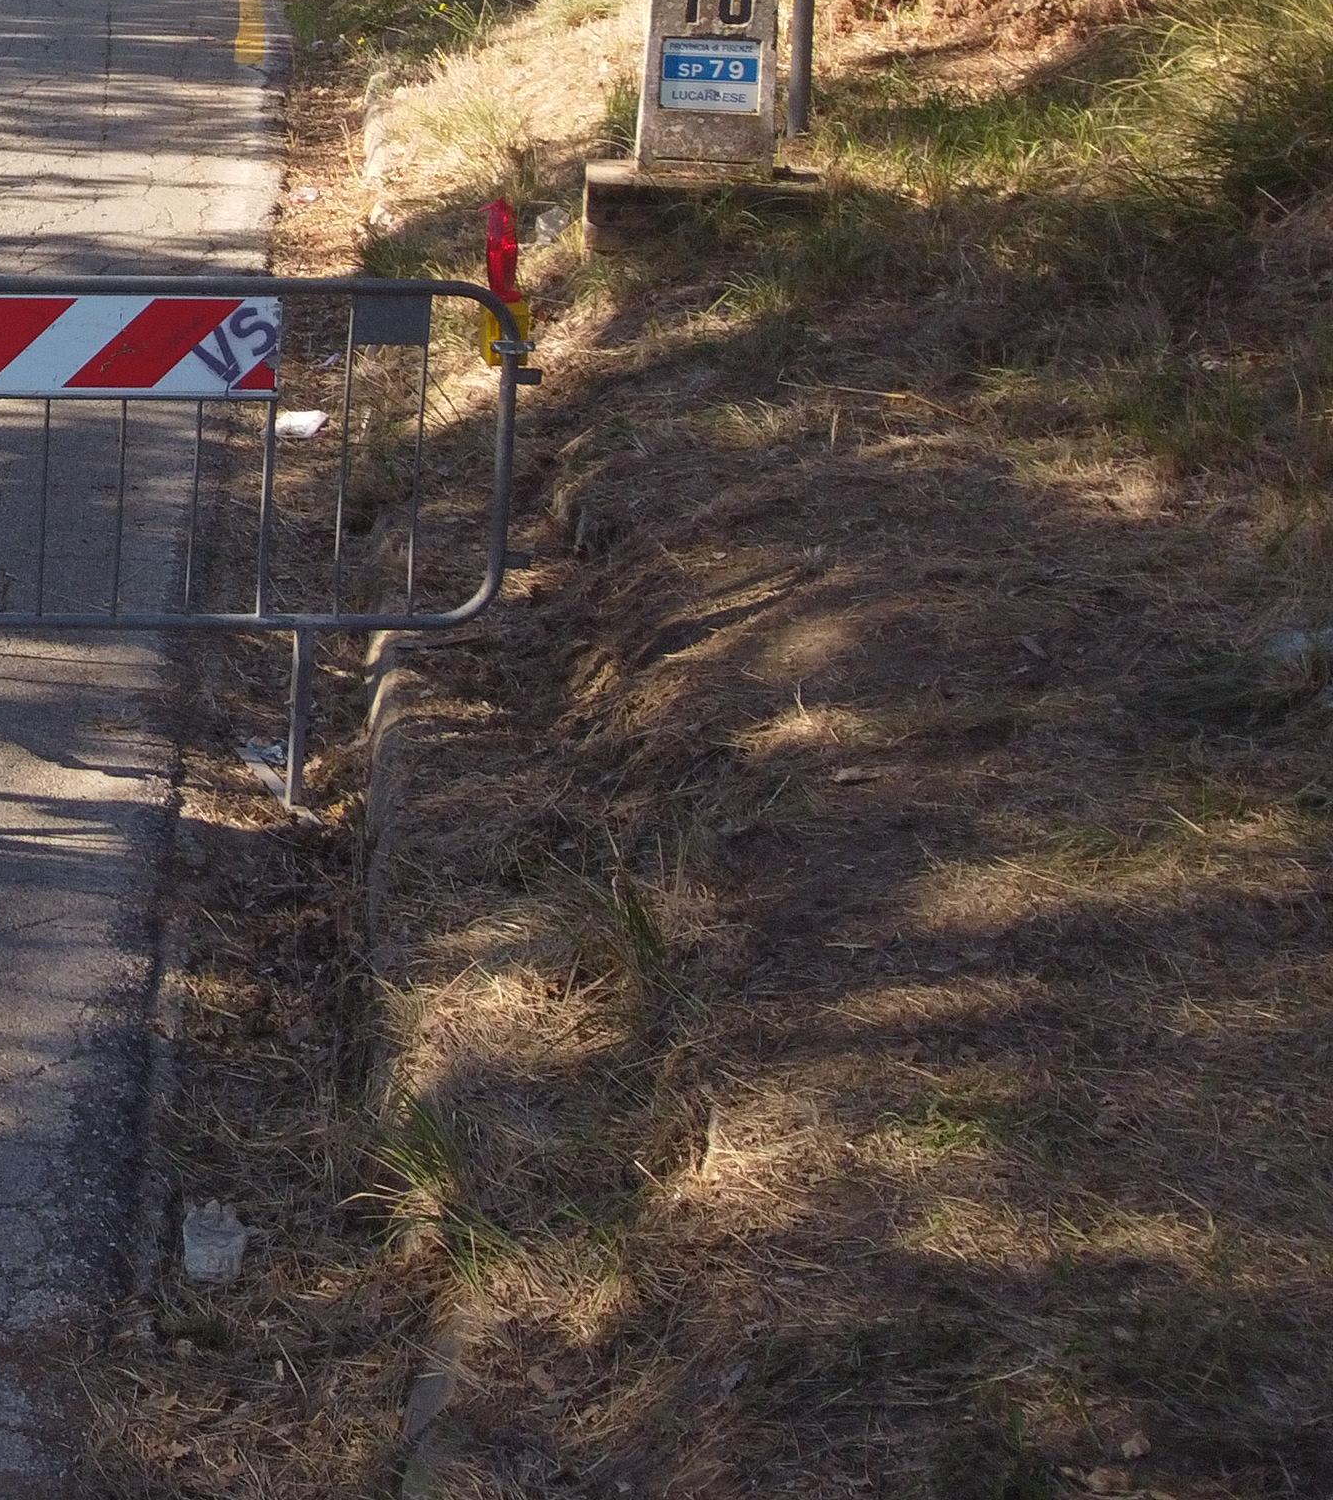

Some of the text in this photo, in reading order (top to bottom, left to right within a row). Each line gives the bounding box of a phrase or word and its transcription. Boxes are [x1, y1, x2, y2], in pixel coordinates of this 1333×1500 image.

[678, 60, 744, 80] SP 79
[192, 306, 278, 384] VS
